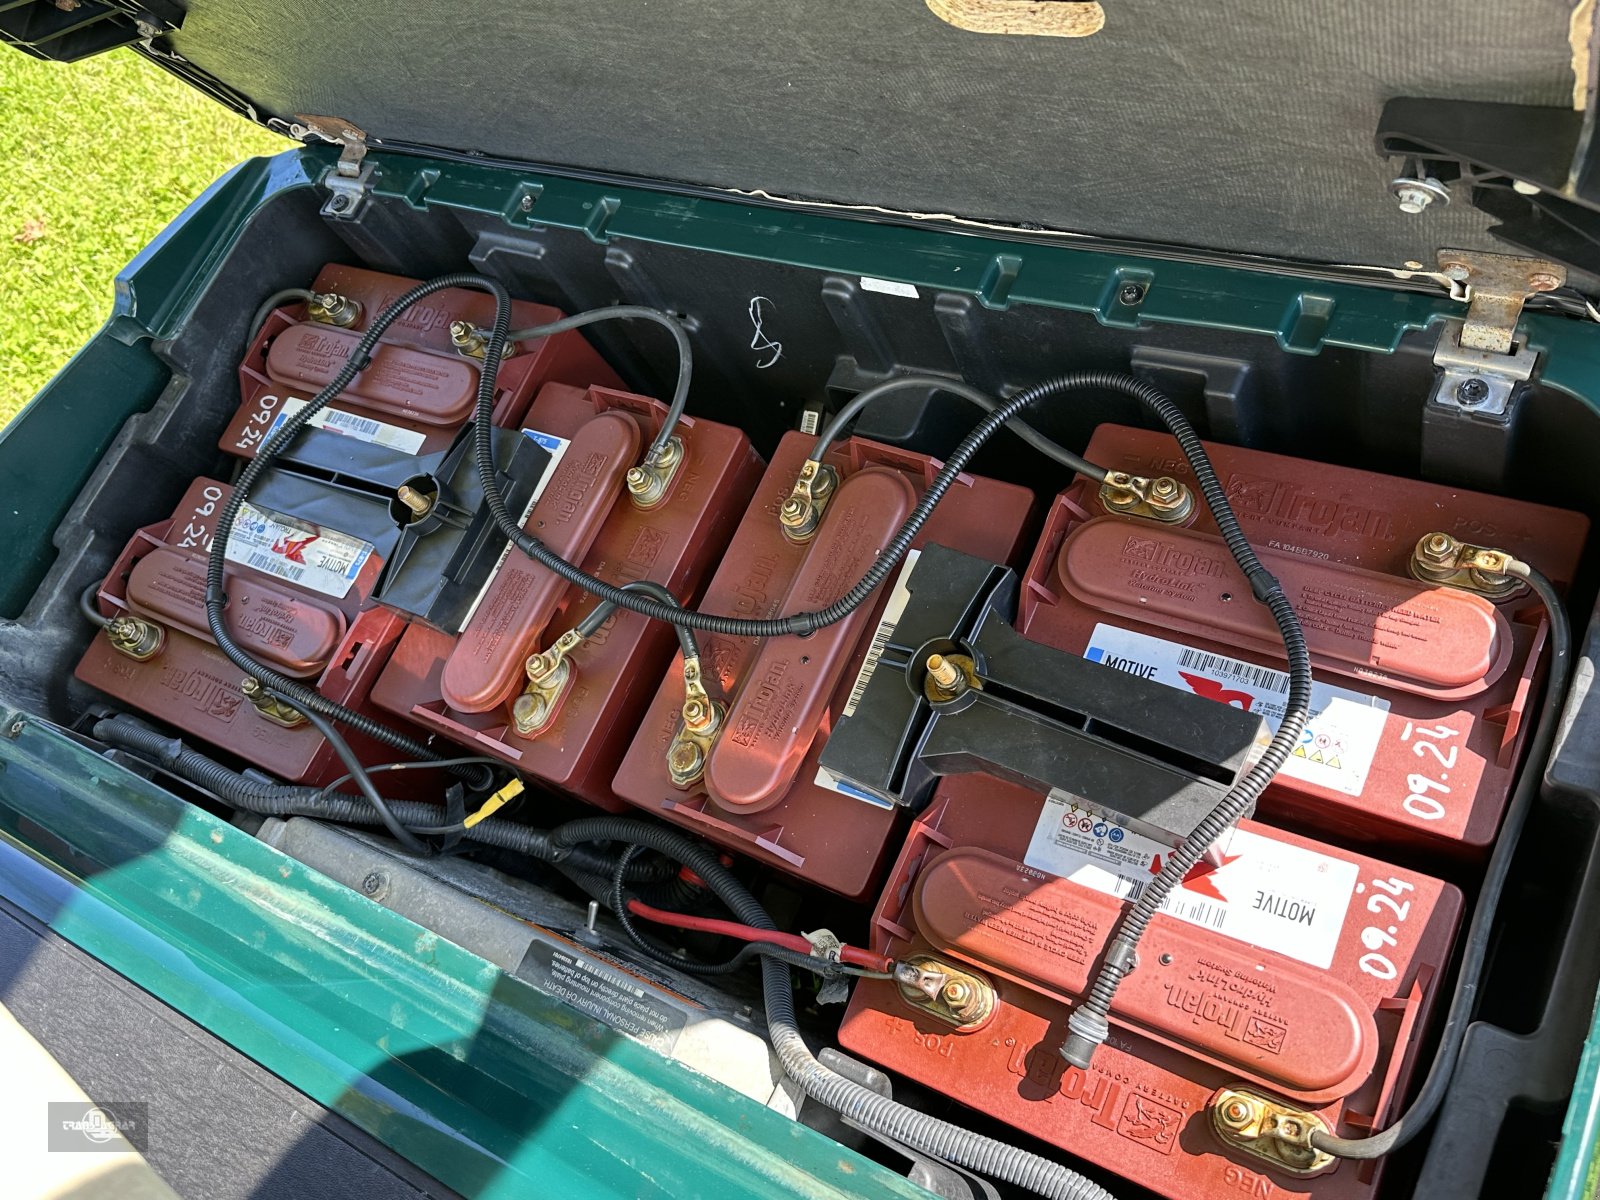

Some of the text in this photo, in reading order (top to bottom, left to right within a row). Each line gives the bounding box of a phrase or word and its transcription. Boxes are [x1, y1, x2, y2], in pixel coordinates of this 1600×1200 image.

[236, 394, 278, 450] 09.24
[555, 470, 596, 527] Trojan
[177, 486, 223, 548] 09.24
[1269, 479, 1398, 549] Trojan
[1267, 539, 1281, 549] FA
[316, 554, 349, 576] MOTIVE
[1154, 540, 1227, 584] Trojan
[236, 613, 275, 644] Trojan
[154, 661, 218, 713] Trojan
[742, 656, 791, 723] Trojan
[1402, 721, 1460, 822] 09.24
[1251, 889, 1316, 926] MOTIVE
[1359, 874, 1416, 980] 09.24
[564, 975, 591, 993] mounting
[572, 970, 582, 980] of
[579, 973, 591, 984] top
[589, 978, 599, 987] on
[564, 989, 578, 1002] OR
[589, 987, 622, 1009] component
[597, 982, 620, 999] directly
[1193, 968, 1274, 1009] HydroLink
[576, 995, 603, 1014] INJURY
[619, 1003, 648, 1022] removing
[632, 1000, 650, 1014] place
[647, 1008, 659, 1018] not
[1161, 972, 1254, 1042] Trojan
[601, 1008, 641, 1034] PERSONAL
[645, 1017, 664, 1031] When
[657, 1013, 668, 1023] do
[911, 1029, 955, 1056] POS
[1087, 1061, 1190, 1110] BATTERY COMPA
[1220, 1164, 1274, 1200] NEG
